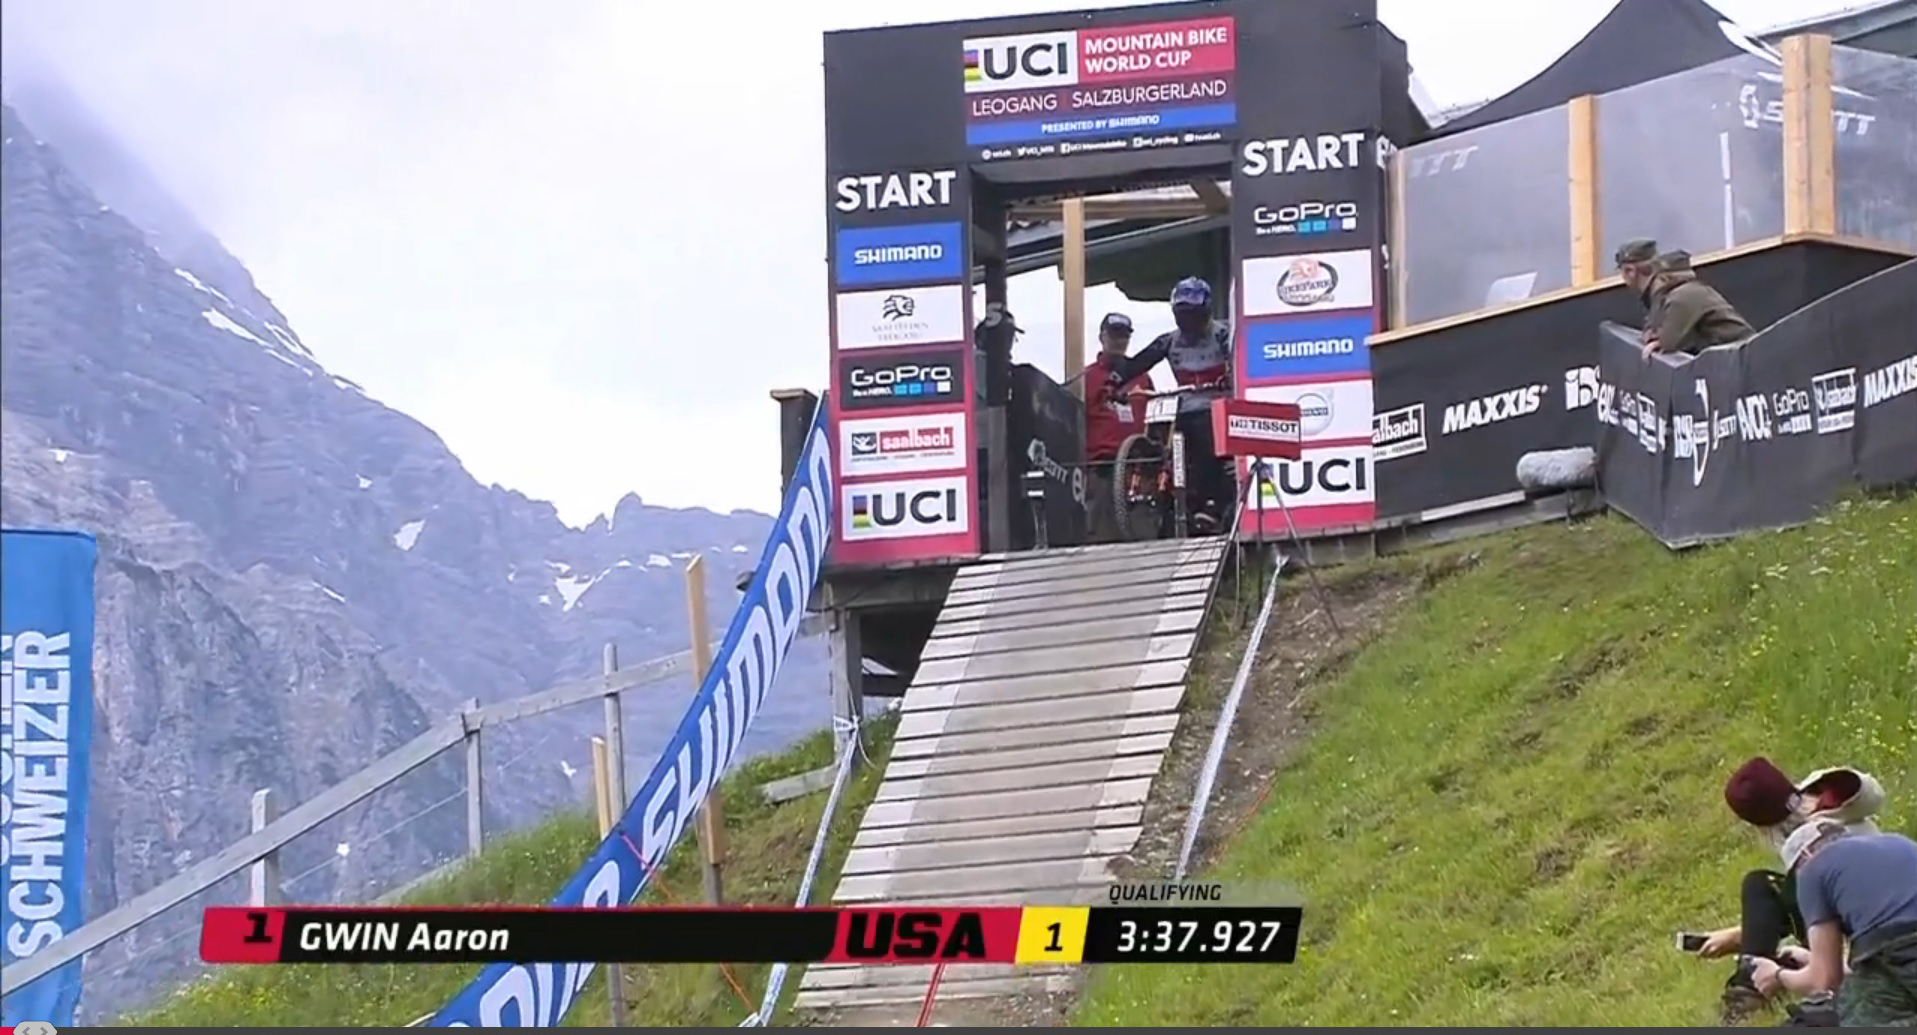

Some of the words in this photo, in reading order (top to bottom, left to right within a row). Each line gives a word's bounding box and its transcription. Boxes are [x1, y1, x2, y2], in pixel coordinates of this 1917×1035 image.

[1085, 32, 1185, 54] MOUNTAIN
[1188, 27, 1227, 45] BIKE
[983, 42, 1068, 80] UCI
[1085, 55, 1153, 74] WORLD
[1155, 51, 1192, 68] CUP
[972, 94, 1057, 117] LEOGANG
[1072, 80, 1227, 109] SALZBURGERLAND
[1041, 120, 1094, 134] PRESENTED
[1096, 119, 1107, 129] BY
[1242, 132, 1364, 176] START
[836, 170, 956, 212] START
[1254, 203, 1356, 224] GoPro
[854, 244, 943, 265] SHIMANO
[1263, 338, 1353, 360] SHIMANO
[851, 365, 951, 387] GoPro
[1249, 419, 1298, 433] TISSOT
[1372, 408, 1418, 444] albach
[1442, 386, 1543, 435] MAXXIS
[1278, 457, 1367, 495] UCI
[871, 489, 956, 526] UCI
[7, 630, 71, 958] SCHWEIZER
